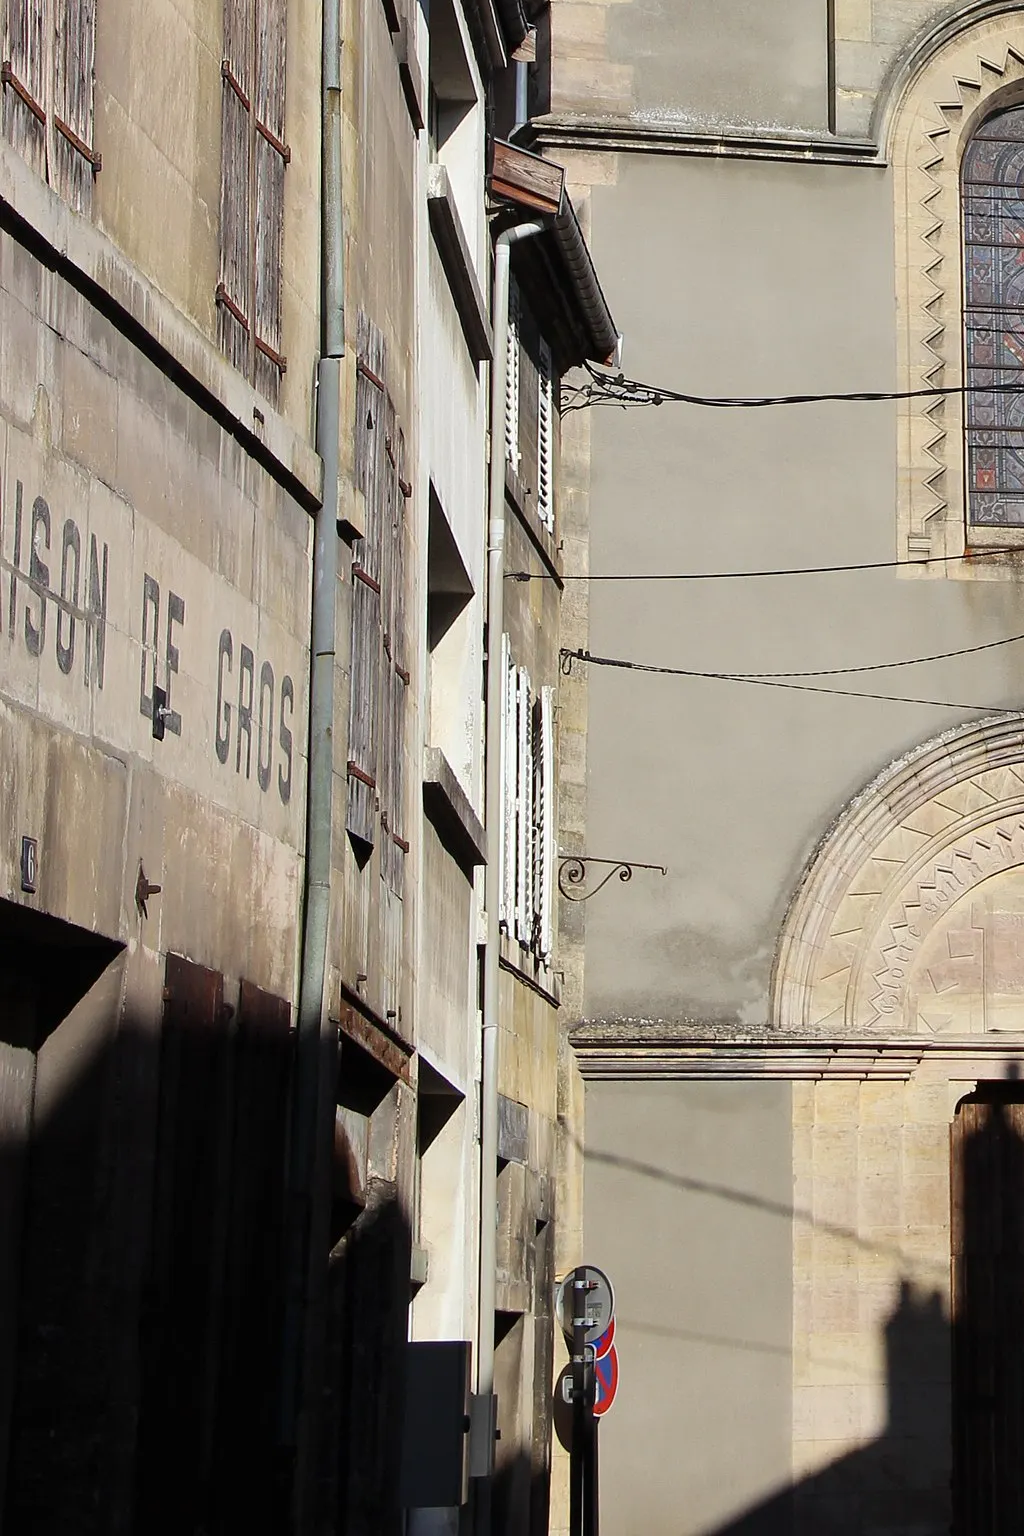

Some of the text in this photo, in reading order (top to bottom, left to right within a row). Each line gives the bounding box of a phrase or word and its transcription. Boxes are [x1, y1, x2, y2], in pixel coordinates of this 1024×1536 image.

[0, 479, 294, 805] ISON DE GROS
[28, 845, 34, 883] 6
